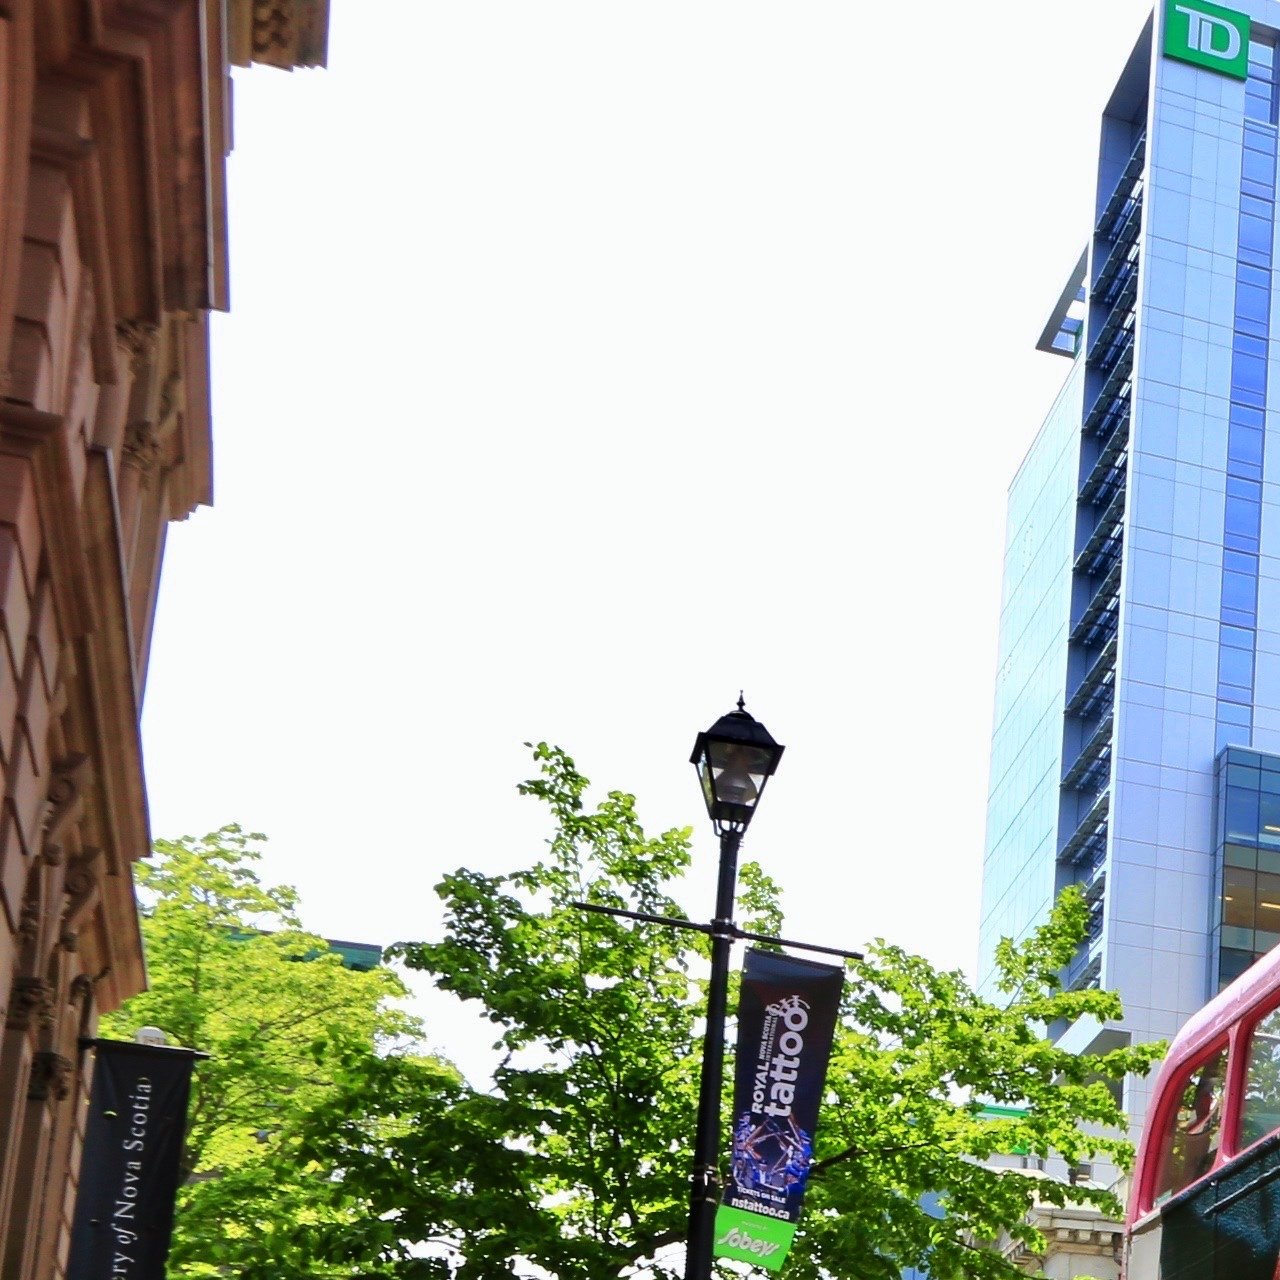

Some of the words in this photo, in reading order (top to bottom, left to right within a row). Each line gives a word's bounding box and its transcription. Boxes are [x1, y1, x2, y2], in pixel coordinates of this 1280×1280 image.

[1174, 4, 1241, 61] TD
[751, 1061, 769, 1114] ROYAL
[764, 1005, 809, 1117] tattoo
[122, 1082, 153, 1152] Scotia
[114, 1159, 143, 1221] Nova
[730, 1197, 790, 1220] nstattoo.ca
[114, 1222, 138, 1246] of
[717, 1226, 780, 1258] Sobeys
